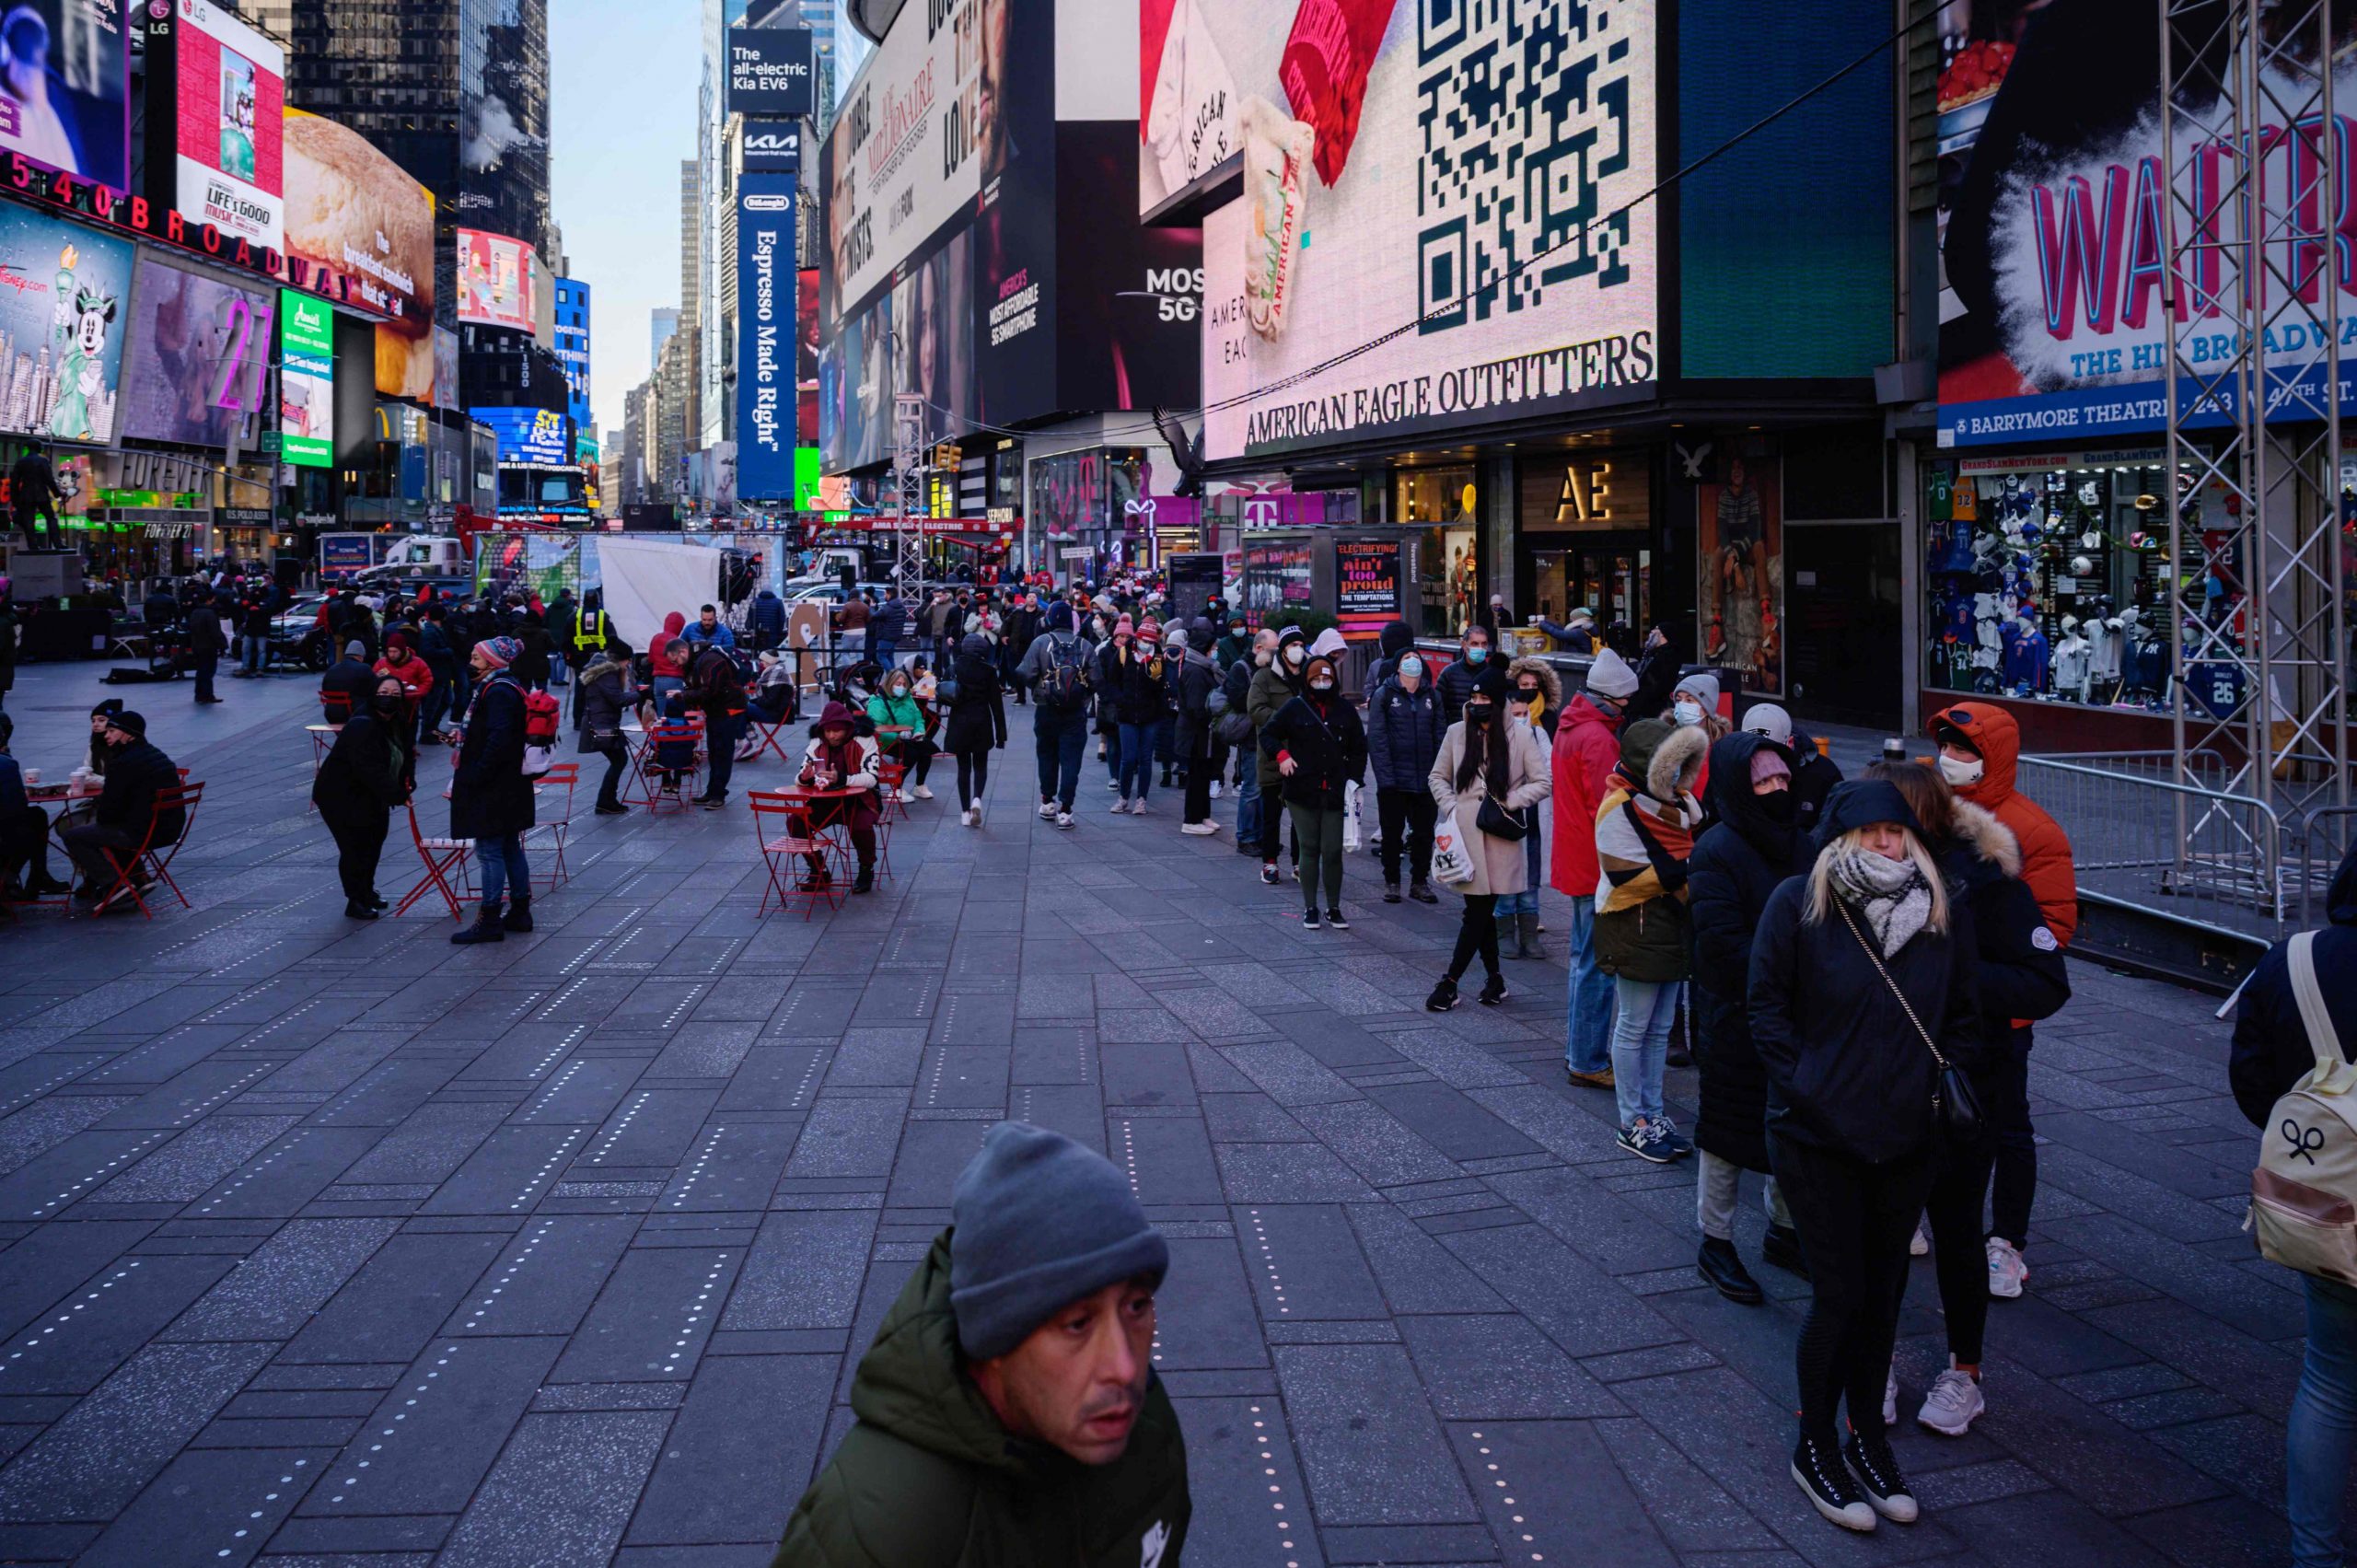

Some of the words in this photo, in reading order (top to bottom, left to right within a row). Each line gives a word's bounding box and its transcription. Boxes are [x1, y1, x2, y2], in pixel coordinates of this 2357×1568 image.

[193, 4, 206, 22] LG
[149, 22, 169, 35] LG
[733, 47, 761, 61] The
[733, 63, 807, 75] all-electric
[733, 77, 756, 90] Kia
[760, 77, 788, 90] EV6
[867, 56, 935, 180] MILLIONAIRE
[944, 77, 981, 181] LOVE
[745, 134, 797, 149] KIA
[205, 203, 234, 224] MUSIC
[239, 201, 271, 226] GOOD
[1273, 203, 1295, 316] AMERICAN
[751, 230, 777, 321] Espresso
[1004, 282, 1039, 319] AFFORDABLE
[1158, 296, 1196, 321] 5G
[999, 307, 1037, 343] SMARTPHONE
[757, 325, 779, 383] Made
[2070, 349, 2122, 378] THE
[1246, 392, 1348, 447] AMERICAN
[1353, 375, 1432, 425] EAGLE
[1437, 330, 1655, 412] OUTFITTERS
[1970, 406, 2079, 435] BARRYMORE
[1553, 460, 1610, 521] AE
[1957, 494, 1972, 506] 32
[987, 507, 1014, 522] SEPHORA
[924, 523, 964, 531] ELECTRIC
[1342, 556, 1382, 571] ain't
[1341, 575, 1394, 595] proud
[1348, 570, 1376, 581] too
[1353, 593, 1394, 601] TEMPTATIONS
[2212, 680, 2235, 704] 26
[1434, 854, 1454, 869] NY
